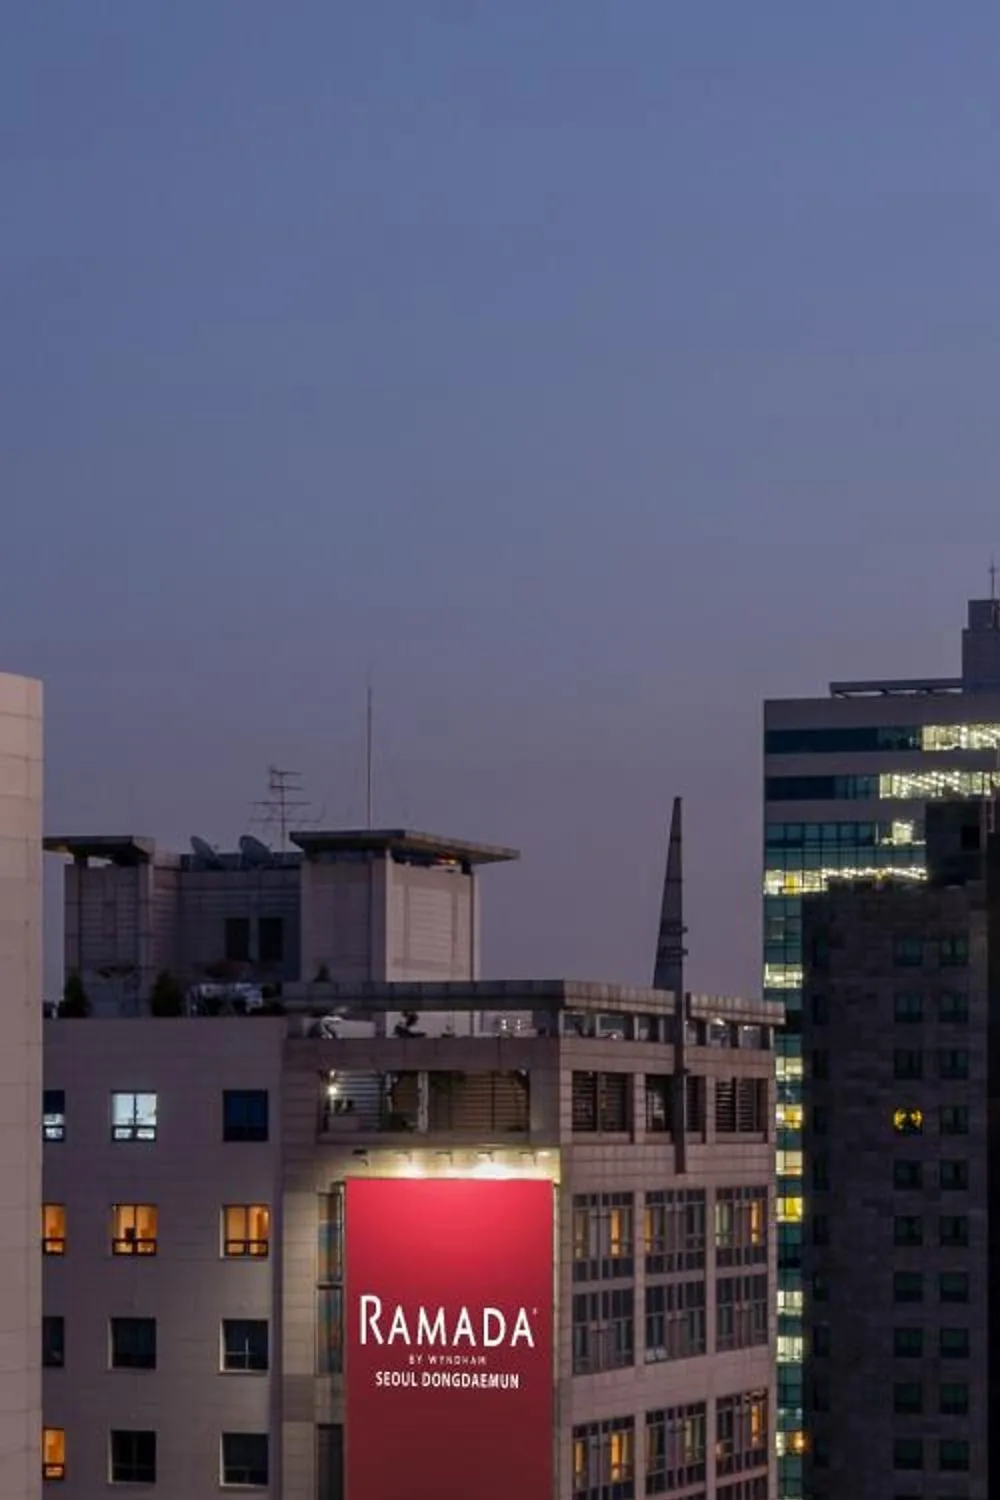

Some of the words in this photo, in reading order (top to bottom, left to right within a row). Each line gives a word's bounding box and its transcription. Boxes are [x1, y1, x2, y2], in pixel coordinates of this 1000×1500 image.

[359, 1294, 536, 1348] RAMADA
[408, 1353, 423, 1366] BY
[427, 1354, 488, 1366] WYNDHAM
[375, 1370, 419, 1387] SEOUL
[421, 1371, 520, 1389] DONGDAEMUN
